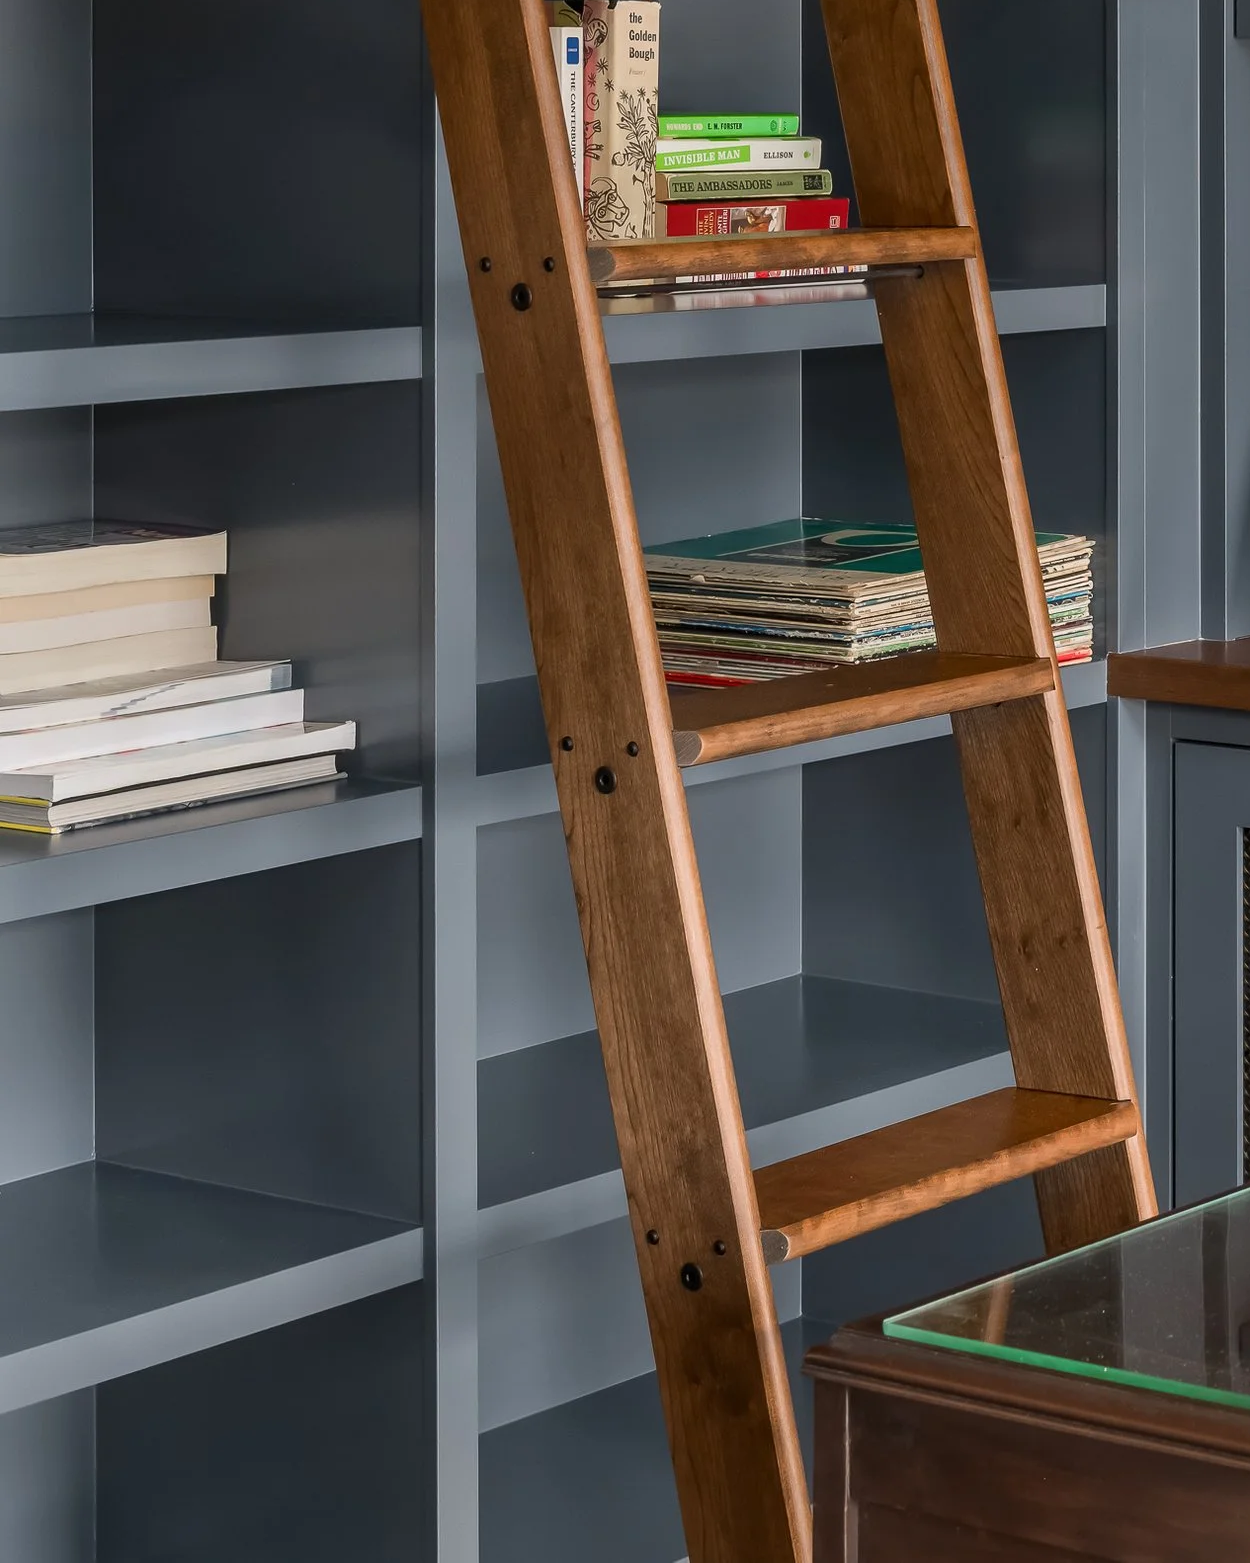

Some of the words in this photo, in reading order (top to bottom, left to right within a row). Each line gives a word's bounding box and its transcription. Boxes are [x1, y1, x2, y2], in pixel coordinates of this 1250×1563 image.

[629, 12, 643, 24] the
[629, 30, 657, 42] Golden
[629, 47, 655, 61] Bough
[569, 93, 577, 159] CANTERBURY
[720, 122, 743, 130] FORSTER
[664, 151, 715, 166] INVISIBLE
[717, 150, 741, 160] MAN
[763, 151, 794, 159] ELLISON
[672, 182, 695, 193] THE
[697, 179, 773, 191] AMBASSADORS
